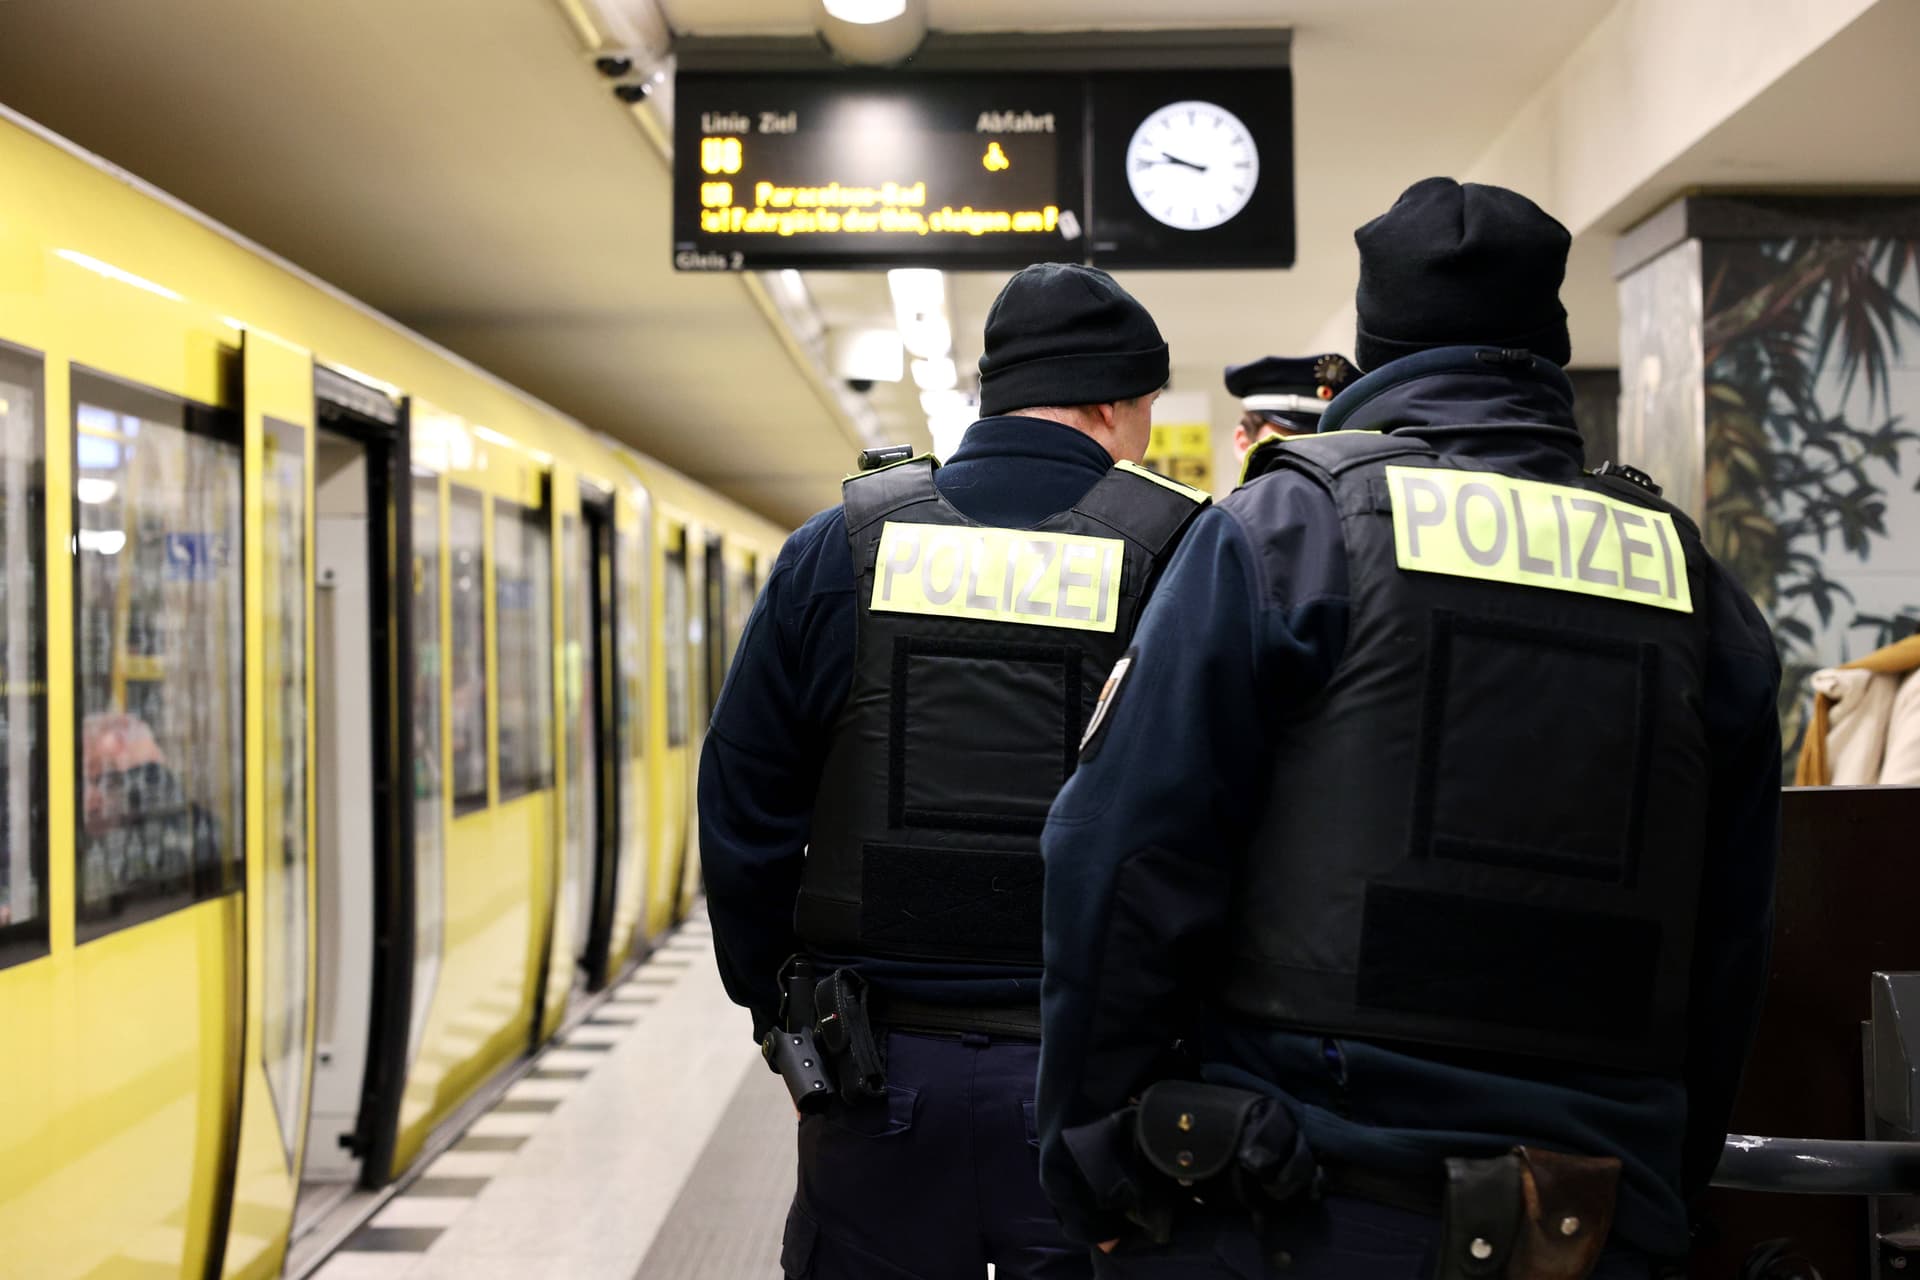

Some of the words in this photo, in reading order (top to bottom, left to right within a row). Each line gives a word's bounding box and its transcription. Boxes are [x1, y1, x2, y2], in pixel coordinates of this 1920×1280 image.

[702, 112, 750, 133] Linie
[758, 112, 798, 133] Ziel
[976, 110, 1056, 133] Abfahrt
[675, 251, 727, 269] Gleis
[731, 251, 744, 269] 2
[1401, 476, 1678, 600] POLIZEI
[881, 527, 1116, 622] POLIZEI
